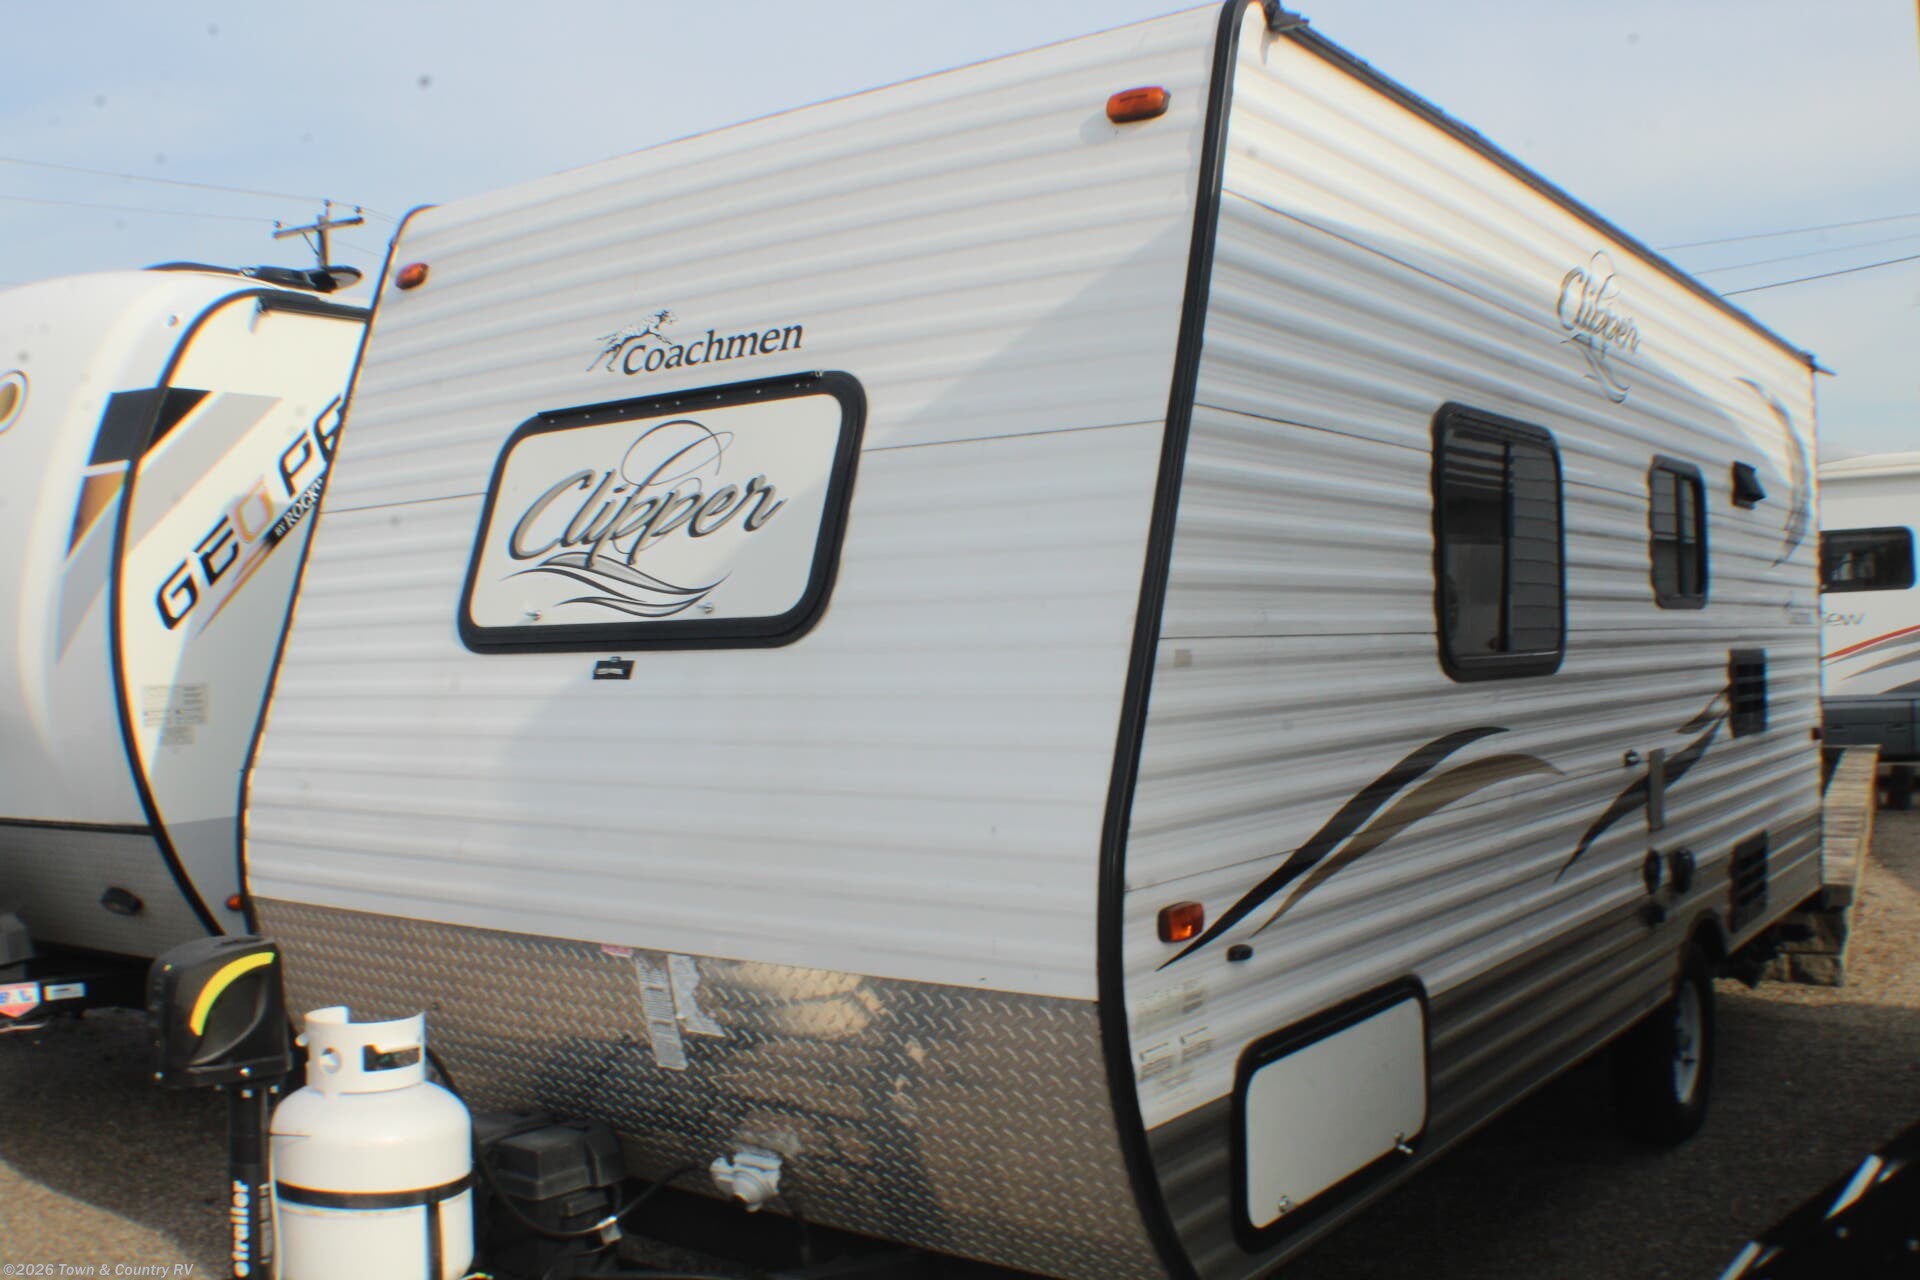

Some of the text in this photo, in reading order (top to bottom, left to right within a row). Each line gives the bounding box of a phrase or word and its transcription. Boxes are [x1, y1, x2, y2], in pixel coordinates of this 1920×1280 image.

[622, 324, 803, 376] Coachmen
[508, 419, 788, 569] Clipper
[230, 1179, 250, 1278] etrailer
